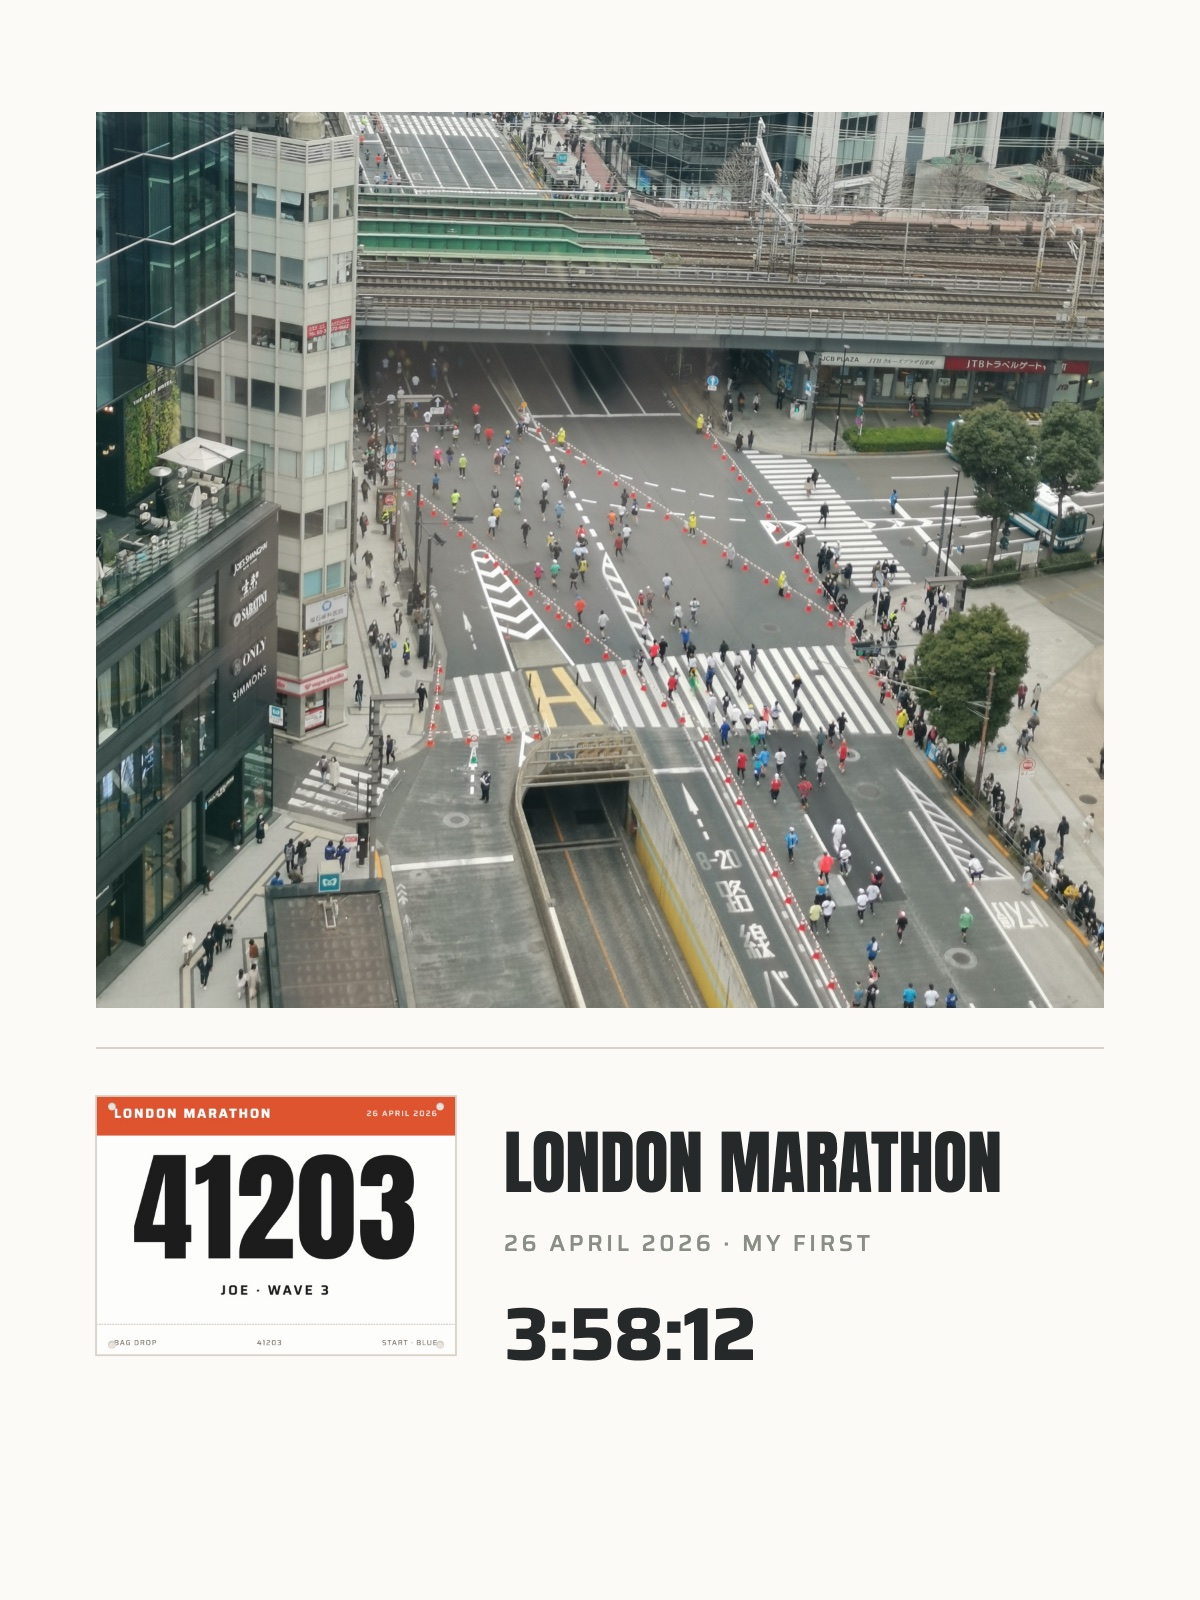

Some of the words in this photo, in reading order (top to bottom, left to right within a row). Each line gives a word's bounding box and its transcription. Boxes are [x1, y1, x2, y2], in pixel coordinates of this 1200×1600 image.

[241, 590, 268, 621] SABATINI
[242, 636, 267, 667] ONLY
[232, 664, 267, 703] SIMMONS
[696, 849, 742, 871] 8-20
